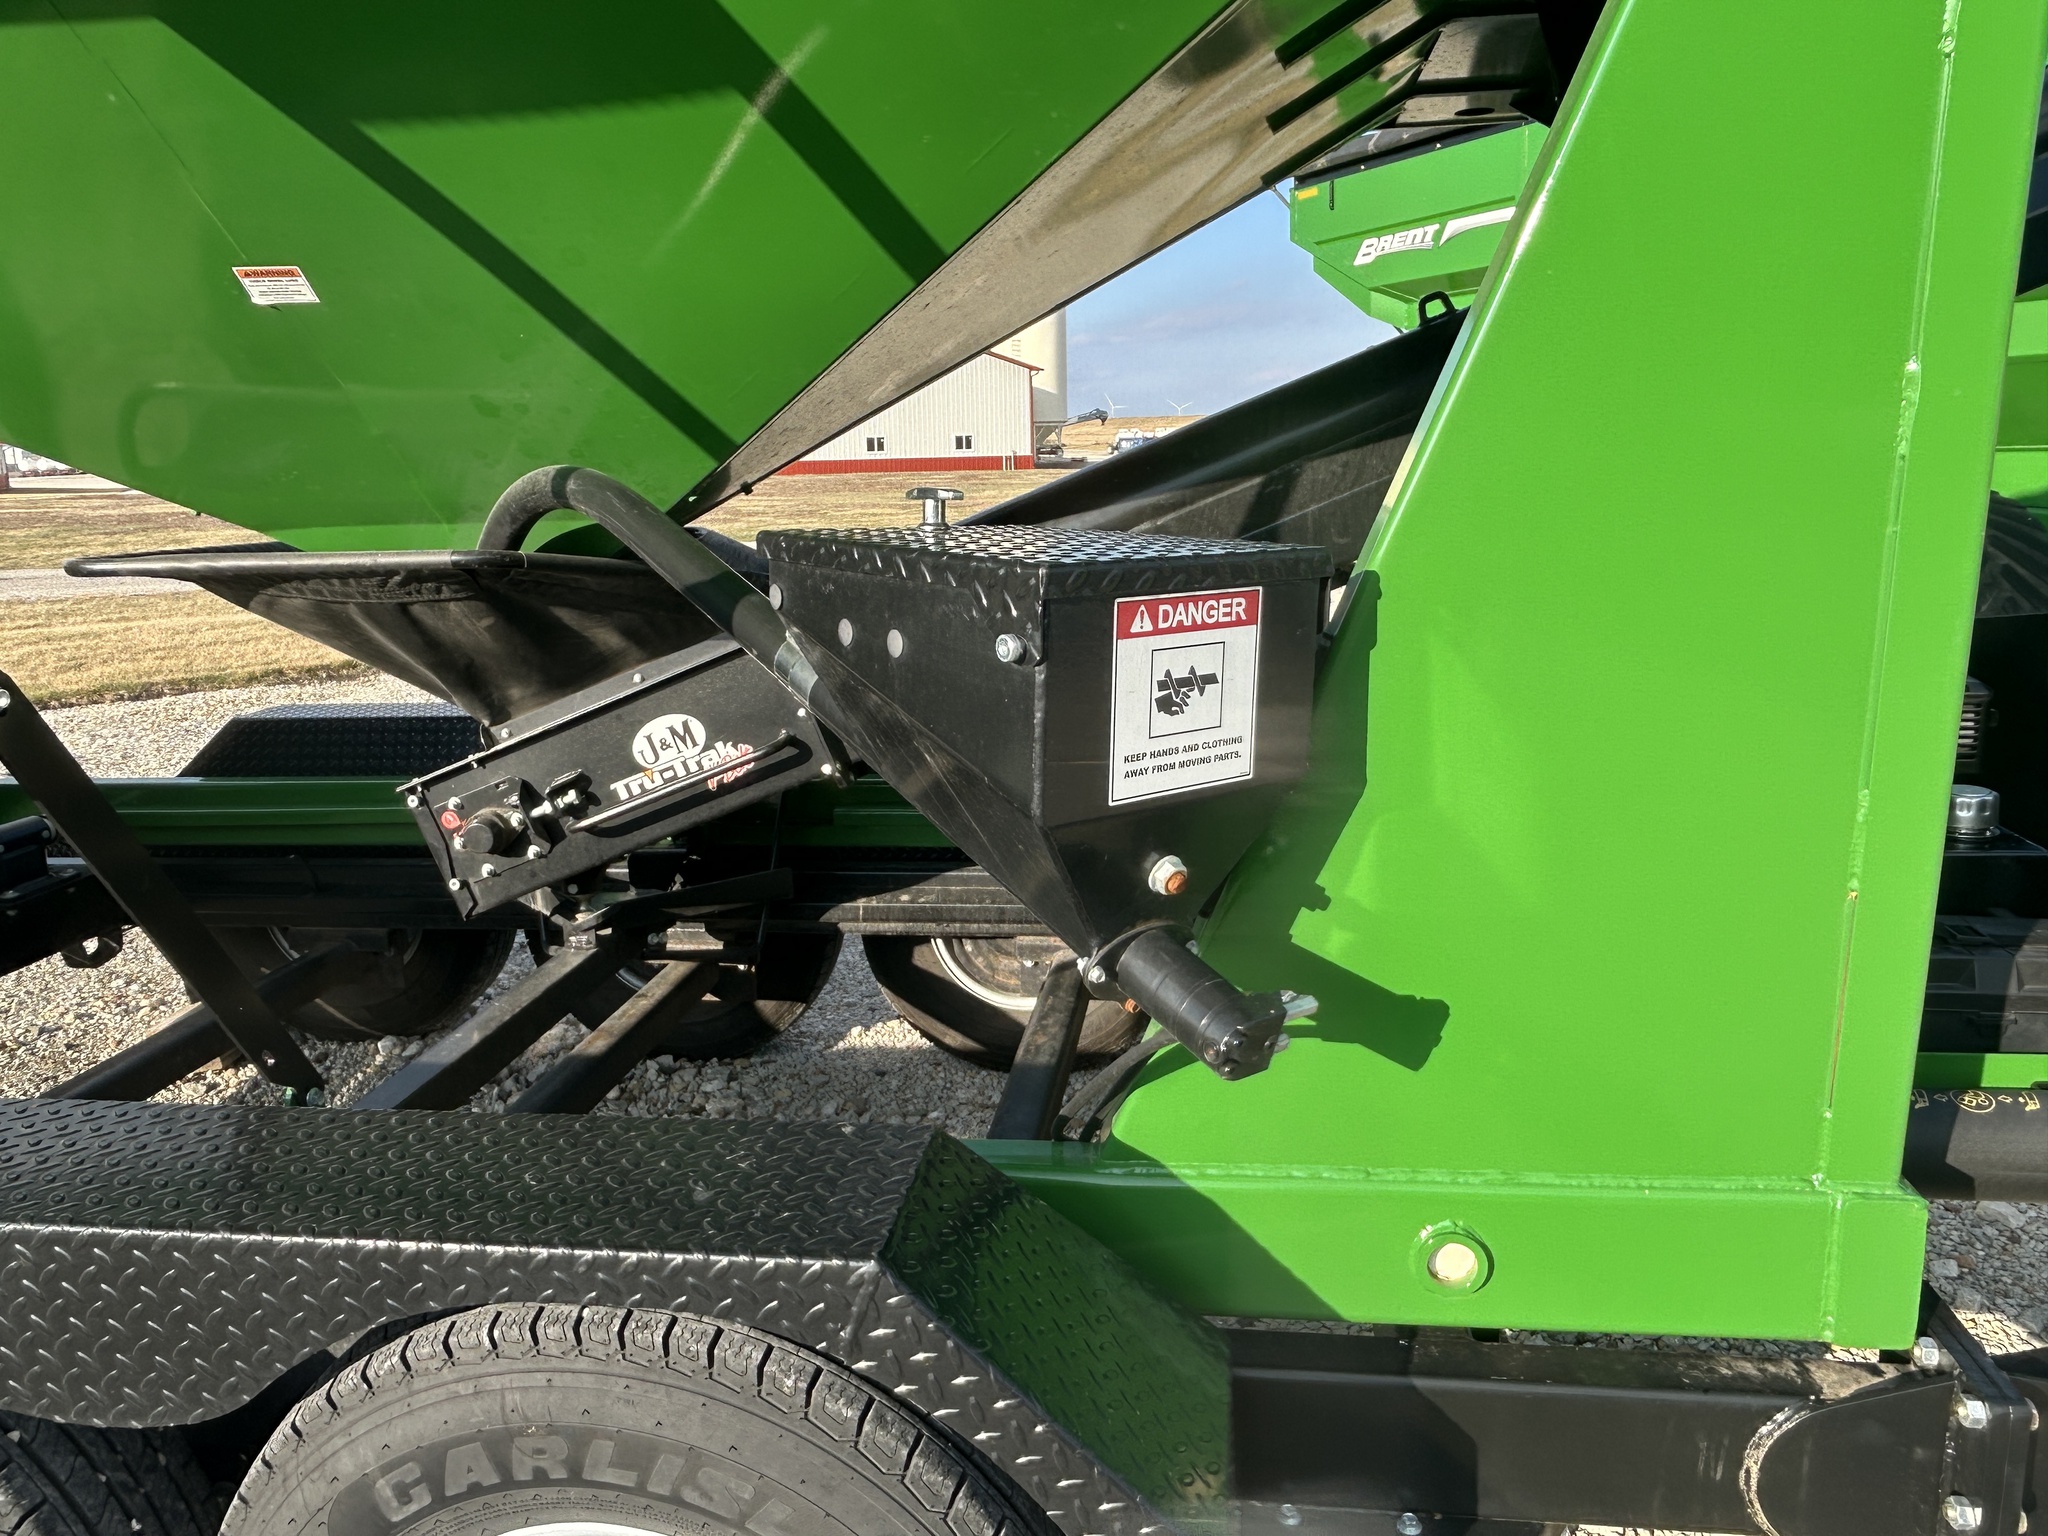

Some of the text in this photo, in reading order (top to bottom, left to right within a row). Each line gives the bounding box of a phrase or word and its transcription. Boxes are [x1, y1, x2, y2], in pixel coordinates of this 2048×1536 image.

[1353, 223, 1440, 266] BRENT
[1158, 597, 1247, 629] DANGER
[638, 718, 700, 765] J&M
[1123, 736, 1243, 764] KEEP HANDS AND CLOTHING
[610, 741, 735, 801] Tru-Trak
[1123, 751, 1242, 779] AWAY FROM MOVING PARTS.
